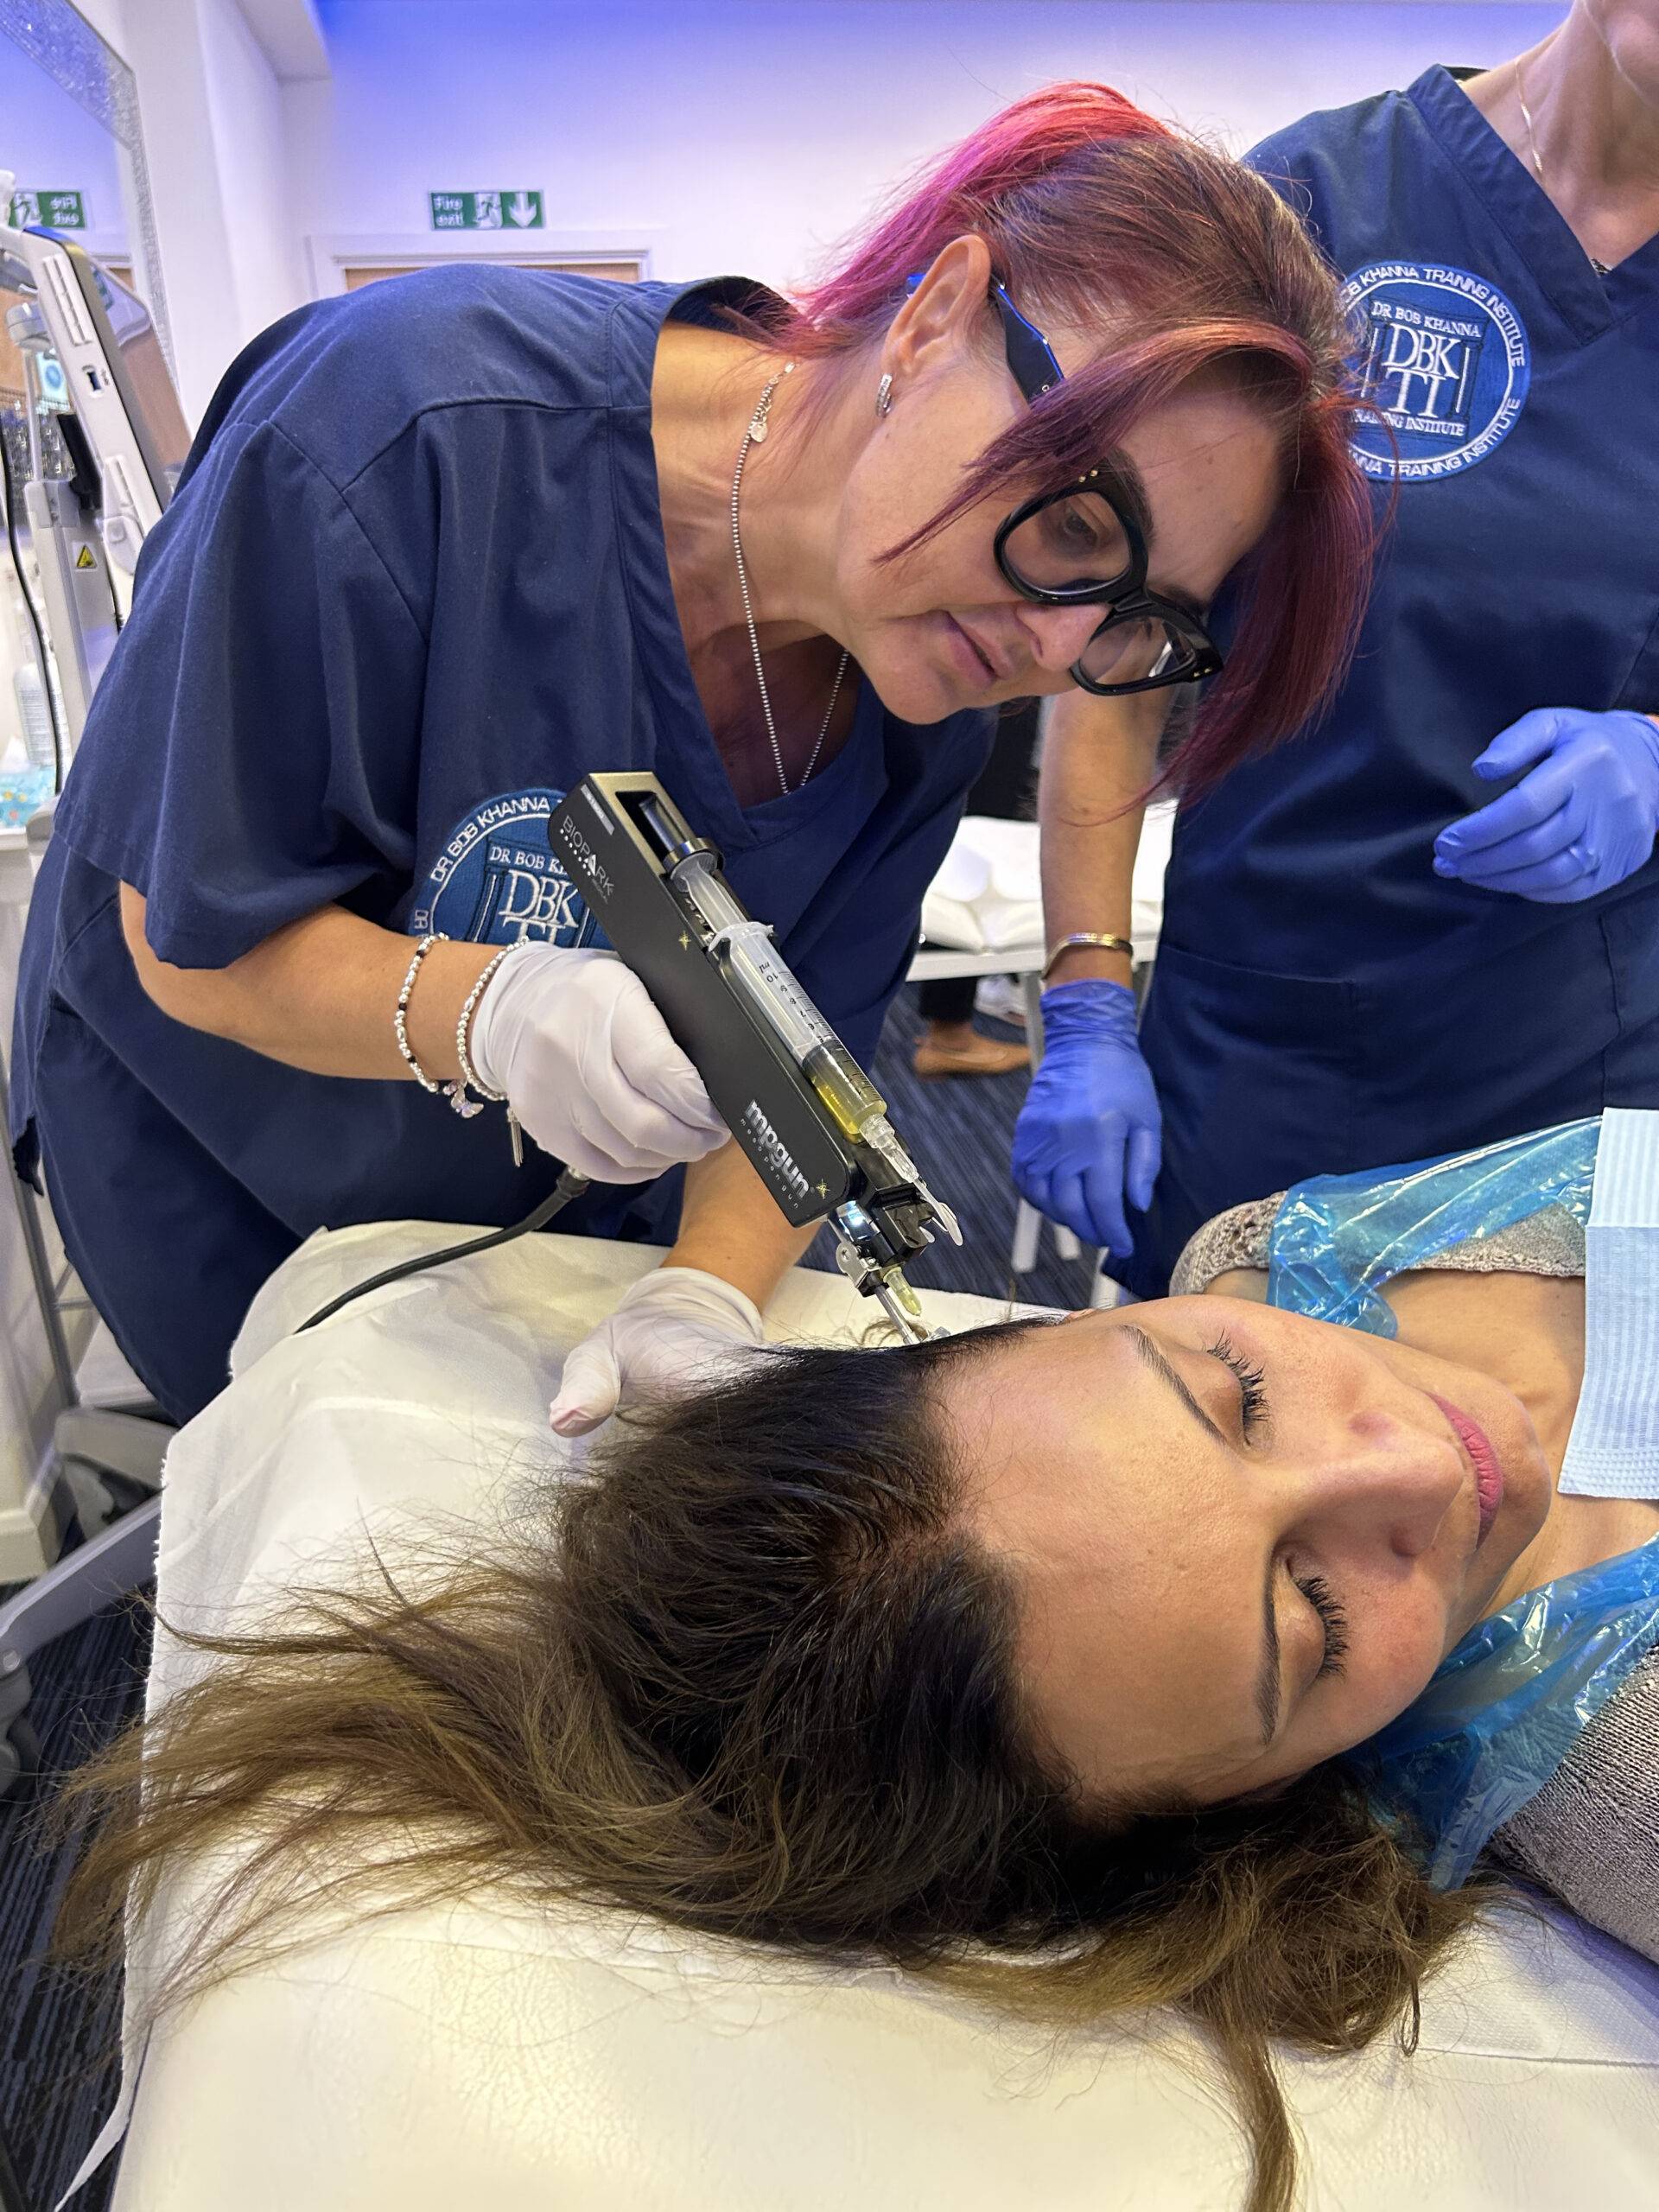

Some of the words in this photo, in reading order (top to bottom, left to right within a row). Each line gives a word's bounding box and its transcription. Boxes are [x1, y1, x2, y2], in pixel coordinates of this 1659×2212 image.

[433, 195, 463, 210] Fire
[435, 213, 464, 226] exit
[1359, 266, 1419, 287] KHANNA
[1423, 268, 1491, 298] TRAINING
[1486, 296, 1525, 367] INSTITUTE
[1371, 302, 1391, 318] DR
[1395, 307, 1421, 325] BOB
[1424, 316, 1482, 337] KHANNA
[1382, 322, 1462, 378] DBK
[1389, 457, 1462, 477] TRAINING
[1462, 397, 1521, 463] INSTITUTE
[1405, 416, 1465, 436] INSTITUTE
[430, 856, 453, 882] DR
[448, 823, 479, 856] BOB
[477, 797, 550, 829] KHANNA
[490, 846, 512, 864] DR
[514, 851, 545, 870] BOB
[563, 815, 614, 896] BIOPARK
[499, 869, 579, 929] DBK
[759, 961, 770, 974] ml
[766, 973, 779, 983] 10
[745, 1098, 810, 1199] mpgun
